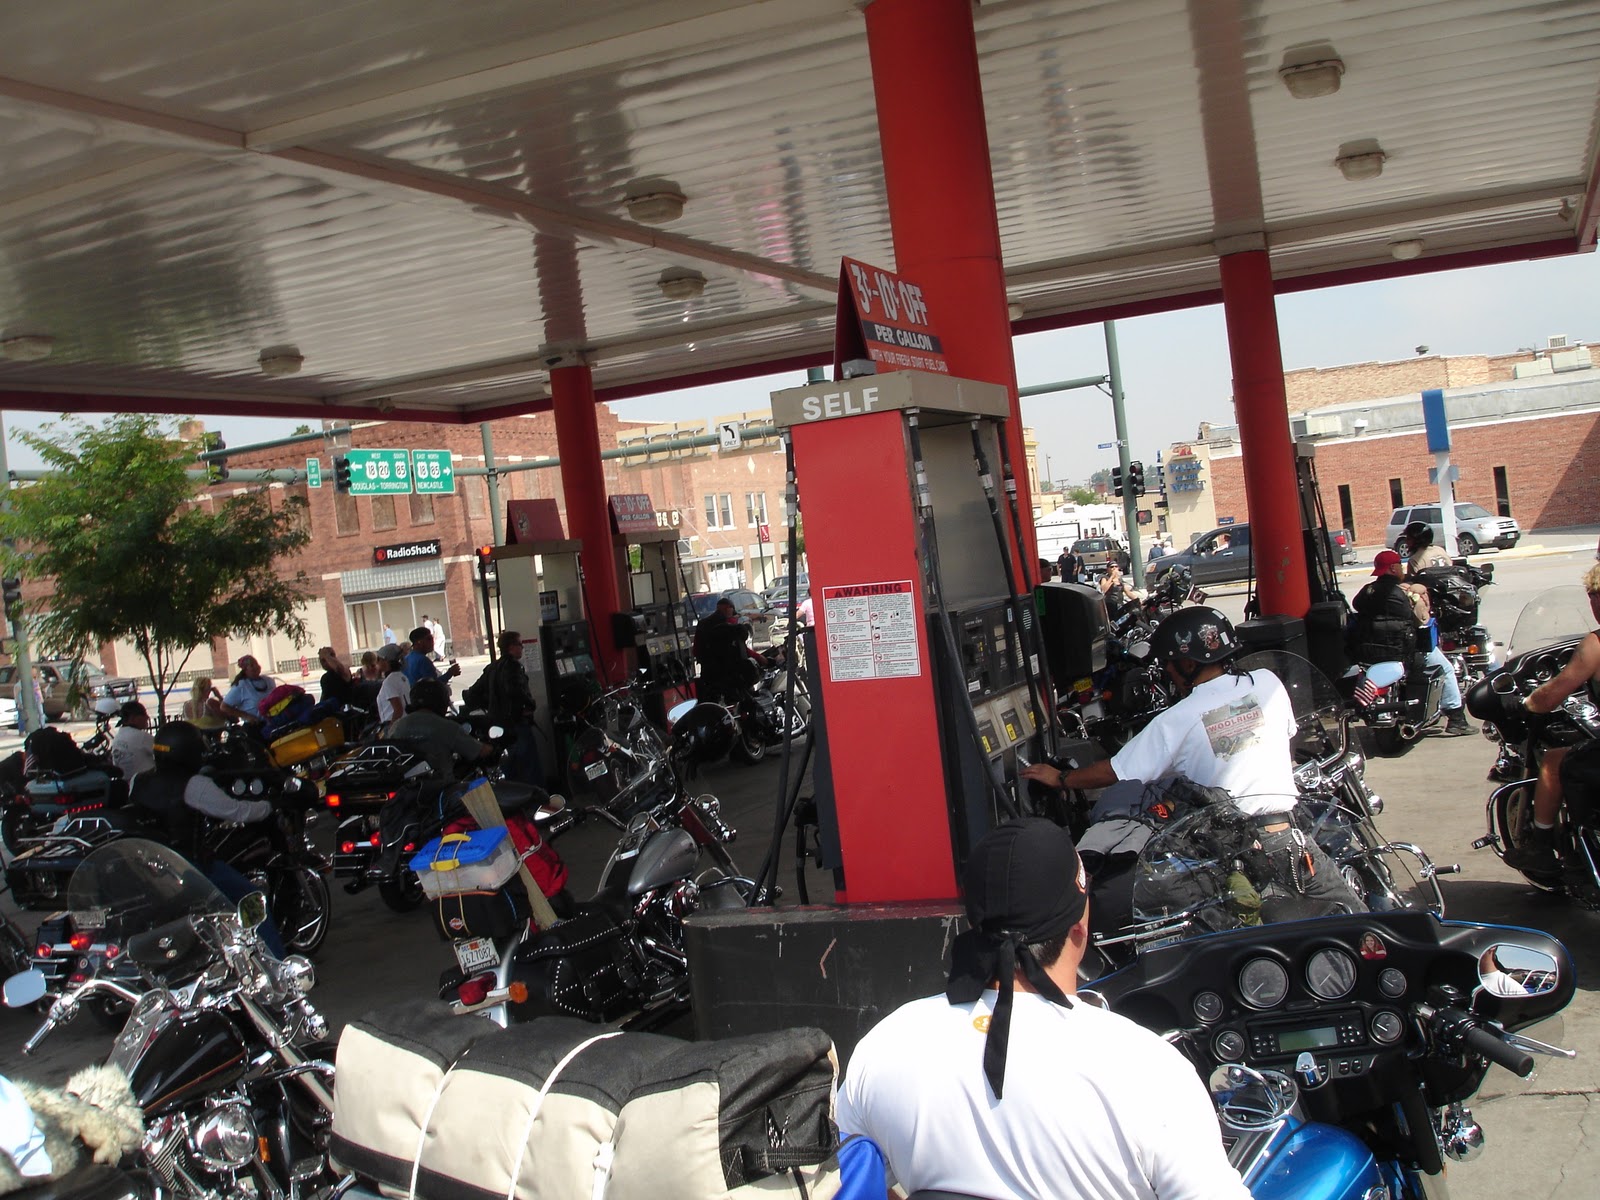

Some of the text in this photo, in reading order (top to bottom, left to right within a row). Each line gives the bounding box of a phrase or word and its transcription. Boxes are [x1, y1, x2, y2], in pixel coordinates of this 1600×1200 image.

[898, 280, 928, 326] OFF
[874, 323, 933, 351] PER GALLON
[883, 350, 896, 364] YOUR
[895, 353, 911, 367] FRESH
[911, 355, 924, 369] START
[924, 358, 937, 370] FUEL
[802, 387, 879, 420] SELF
[367, 463, 406, 475] 18 20 85
[418, 464, 440, 476] 18 85
[352, 482, 376, 490] DOUGLAS
[380, 481, 408, 490] TORRINGTON
[417, 481, 444, 489] NEWCASTLE
[386, 543, 437, 559] RadioShack
[842, 583, 902, 597] WARNING
[1208, 710, 1260, 732] WOOLRICH
